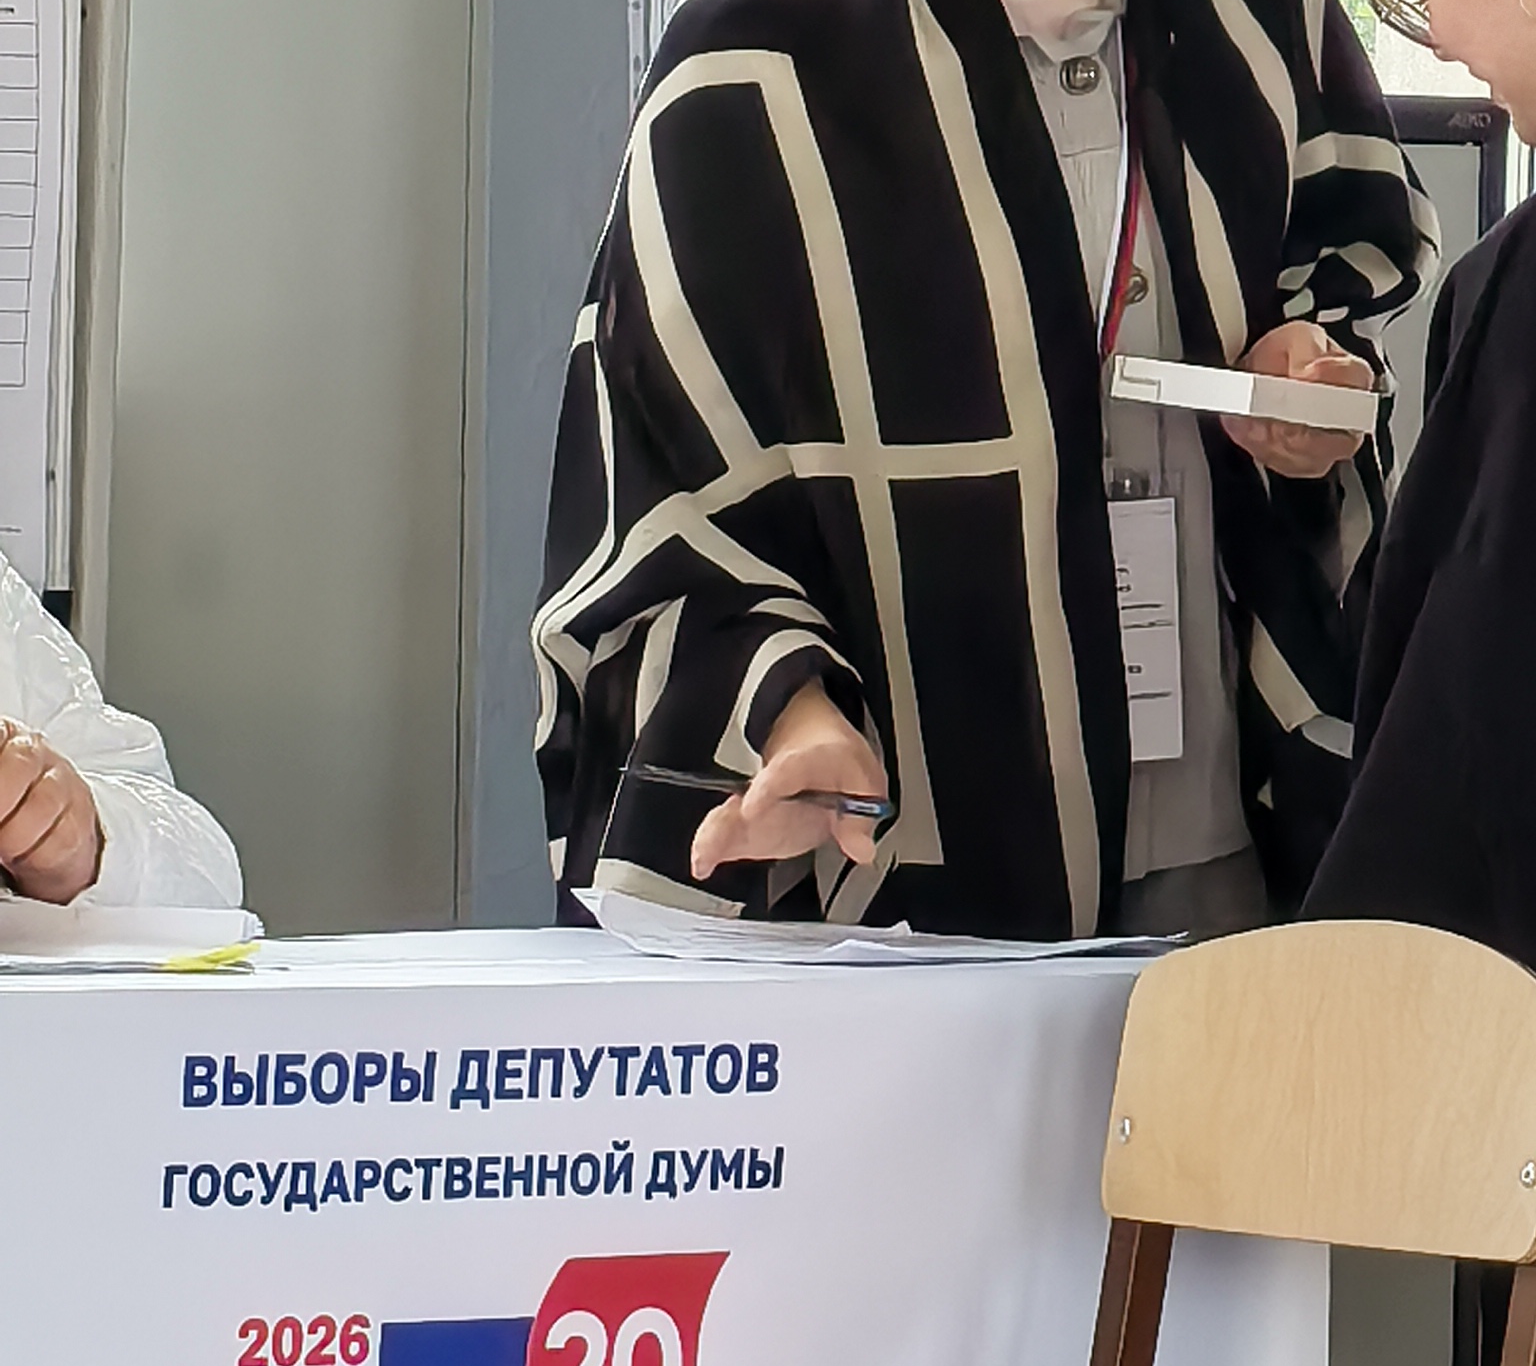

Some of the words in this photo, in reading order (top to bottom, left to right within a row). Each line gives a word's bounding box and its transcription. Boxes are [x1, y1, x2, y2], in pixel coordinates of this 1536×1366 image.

[183, 1051, 437, 1107] ВЫБОРЫ
[450, 1043, 778, 1109] ДЕПУТАТОВ
[163, 1140, 633, 1212] ГОСУДАРСТВЕННОЙ
[645, 1147, 784, 1200] ДУМЫ
